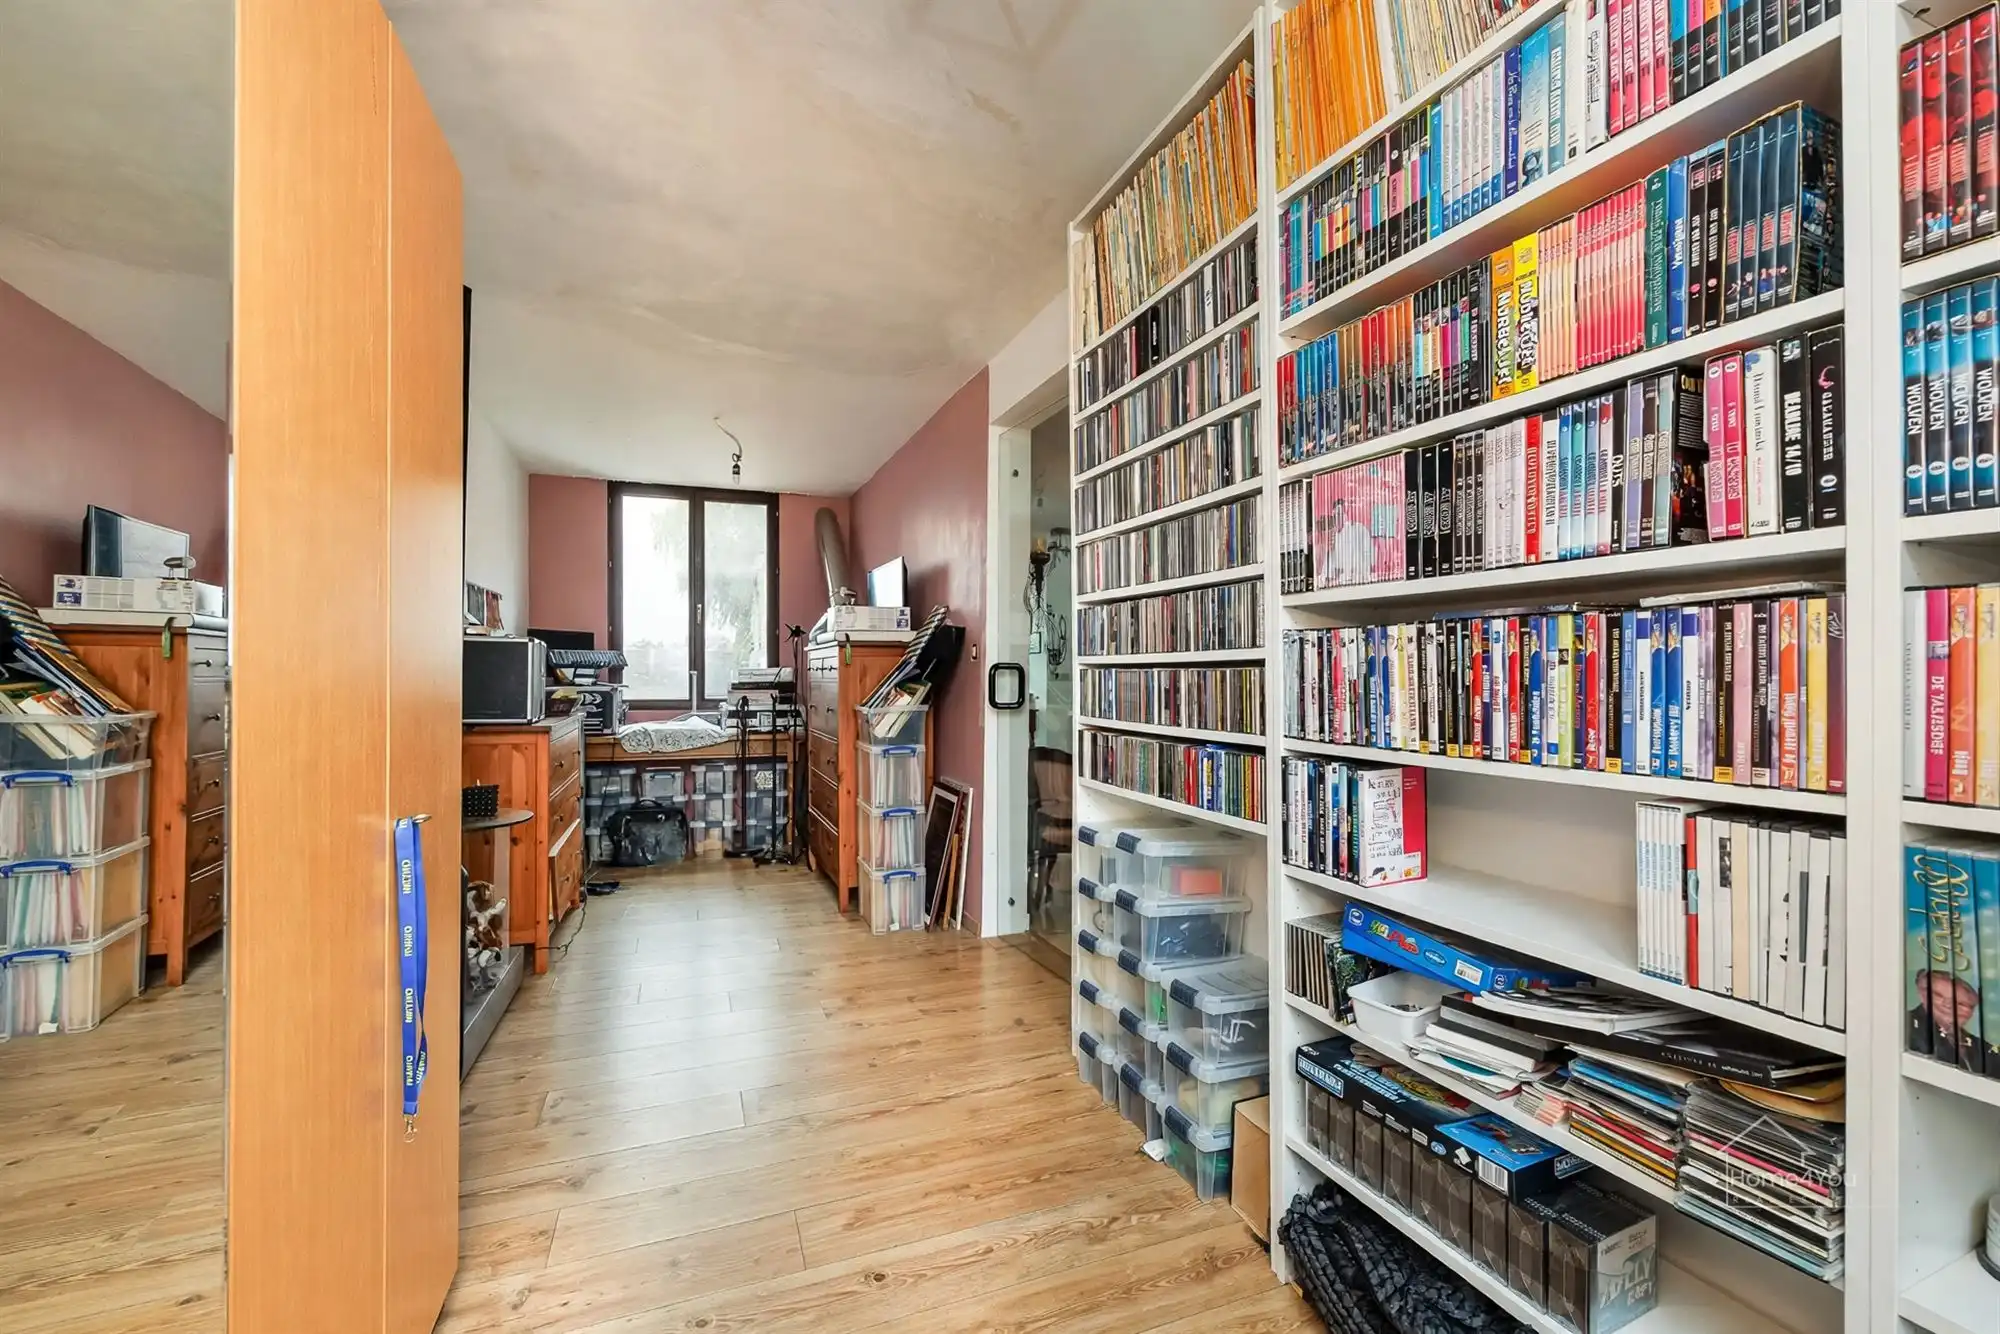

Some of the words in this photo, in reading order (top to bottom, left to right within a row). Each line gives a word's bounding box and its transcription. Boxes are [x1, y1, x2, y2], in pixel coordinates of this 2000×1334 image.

[1906, 384, 1923, 435] WOLVEN
[1929, 379, 1946, 431] WOLVEN
[1953, 373, 1970, 426] WOLVEN
[1977, 367, 1993, 421] WOLVEN
[1785, 443, 1802, 477] 14/10
